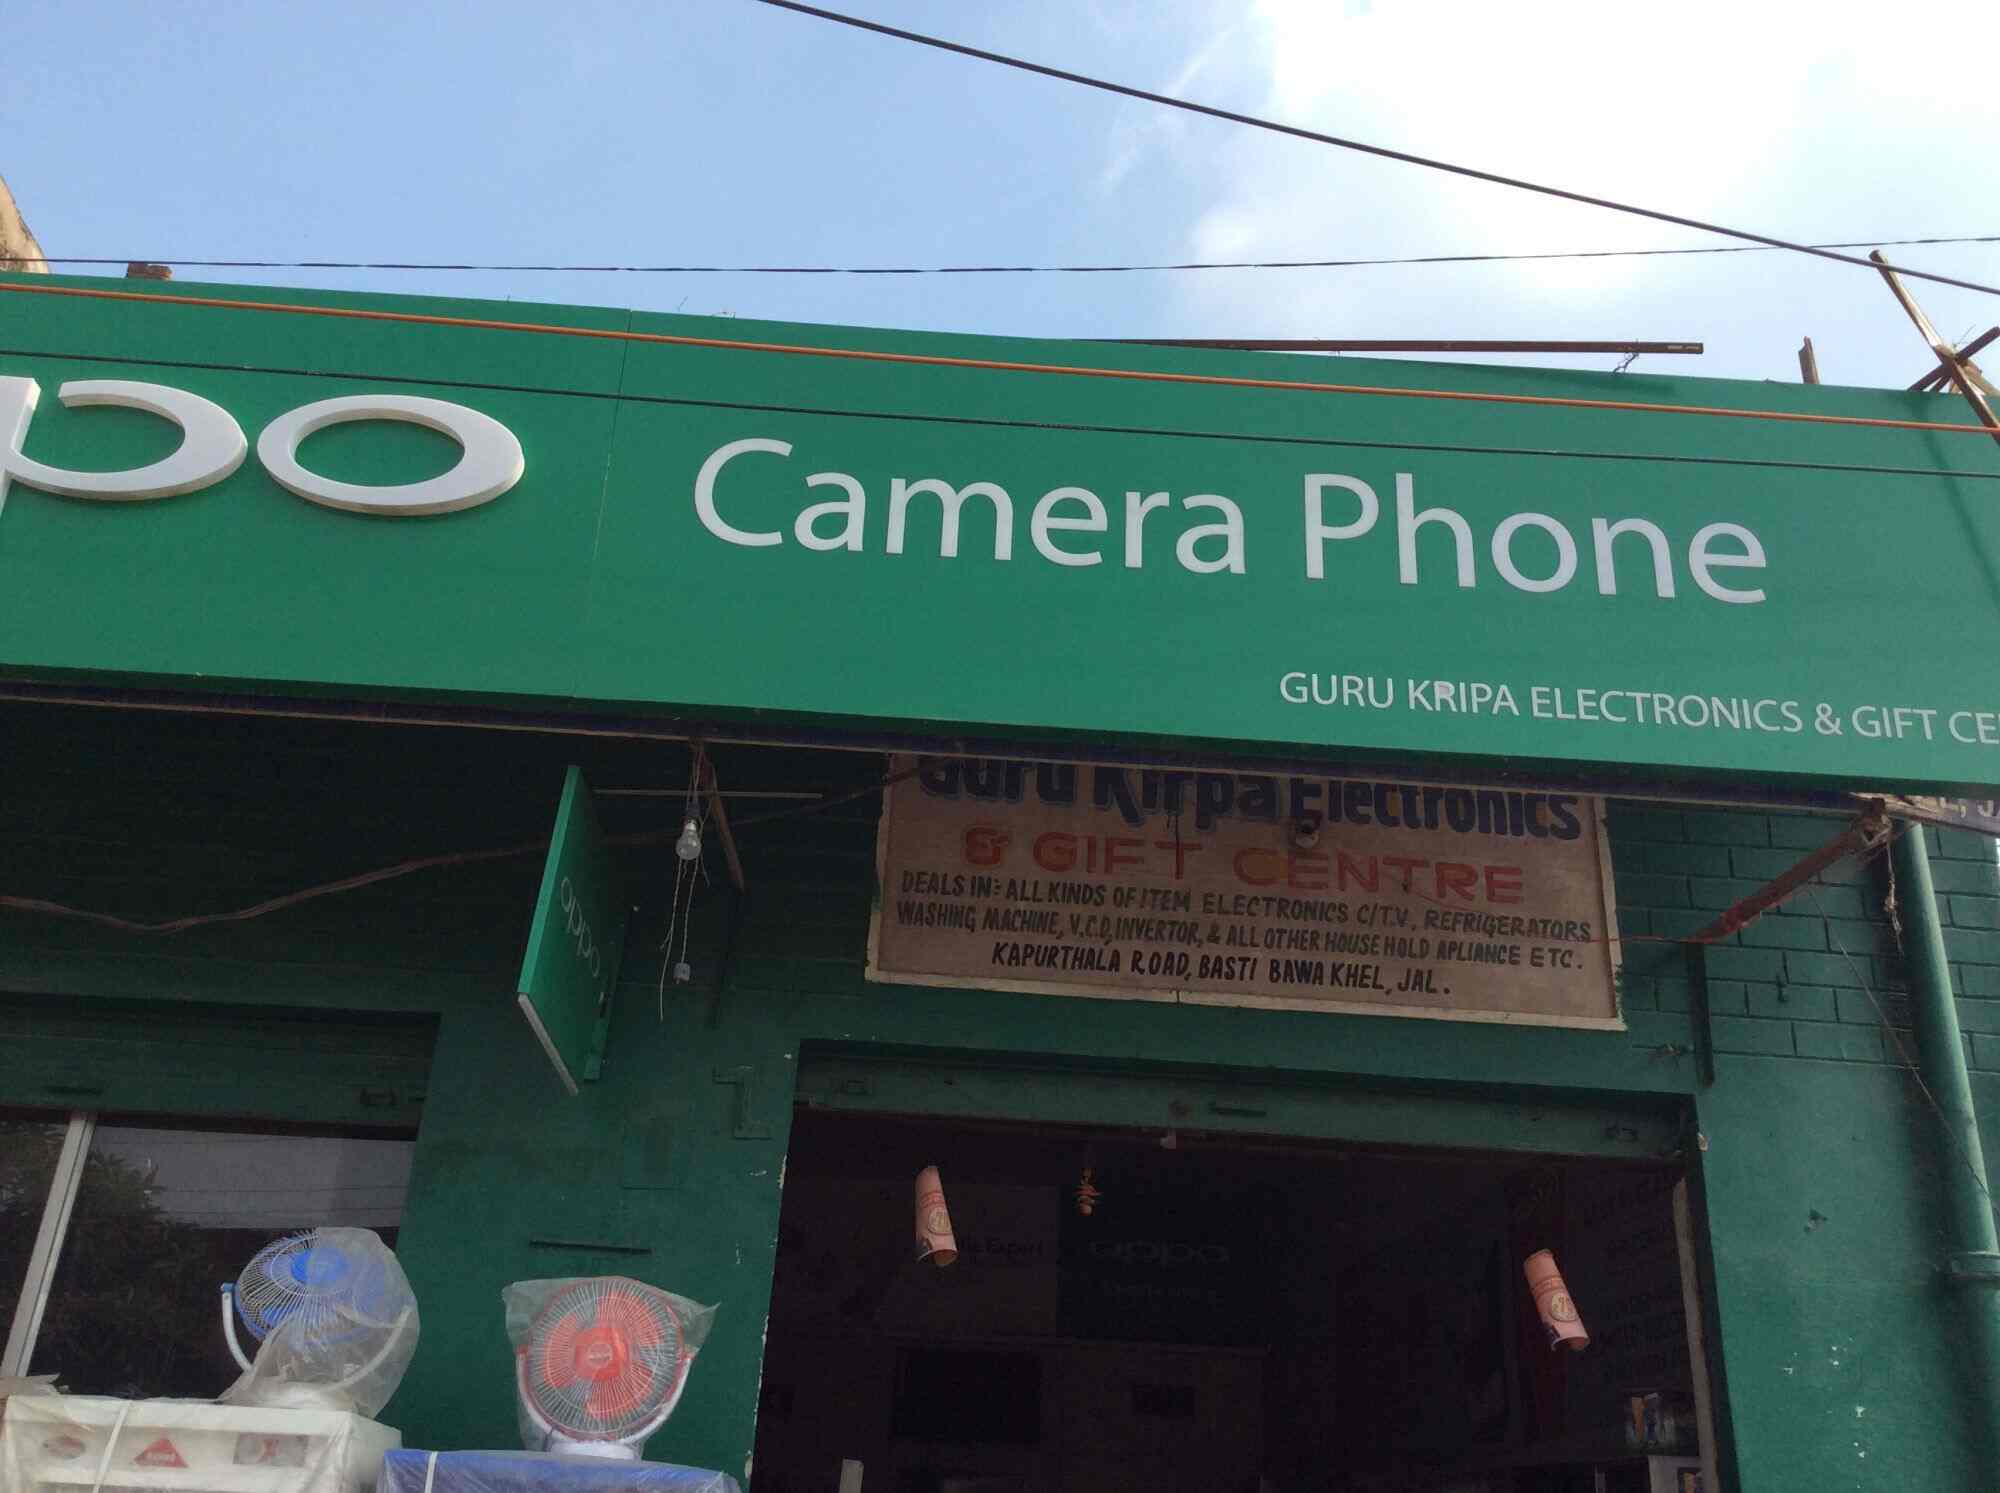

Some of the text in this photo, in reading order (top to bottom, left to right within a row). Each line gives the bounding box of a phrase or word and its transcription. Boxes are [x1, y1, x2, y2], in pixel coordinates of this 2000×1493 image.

[694, 437, 1767, 604] Camera Phone
[1279, 671, 1394, 709] GURU
[1407, 678, 1520, 717] KRIPA
[1530, 686, 1803, 733] ELECTRONICS
[1814, 703, 1843, 736] &
[1851, 705, 1937, 741] GIFT
[1032, 832, 1203, 880] GIFT
[1233, 847, 1524, 904] CENTRE
[902, 870, 965, 898] DEALS
[1005, 878, 1043, 903] ALL
[1047, 882, 1105, 907] KINDS
[1113, 888, 1137, 909] OF
[1203, 892, 1349, 924] ELECTRONICS
[1424, 909, 1591, 942] REFRIGERATORS
[991, 942, 1121, 973] KAPURTHALA
[1130, 951, 1191, 981] ROAD,
[1198, 954, 1258, 981] BASTI
[1269, 957, 1325, 986] BAWA
[1206, 921, 1220, 944] &
[1225, 924, 1257, 948] ALL
[1264, 927, 1321, 952] OTHER
[1325, 931, 1380, 956] HOUSE
[1383, 936, 1430, 960] HOLD
[1529, 947, 1583, 970] ETC.
